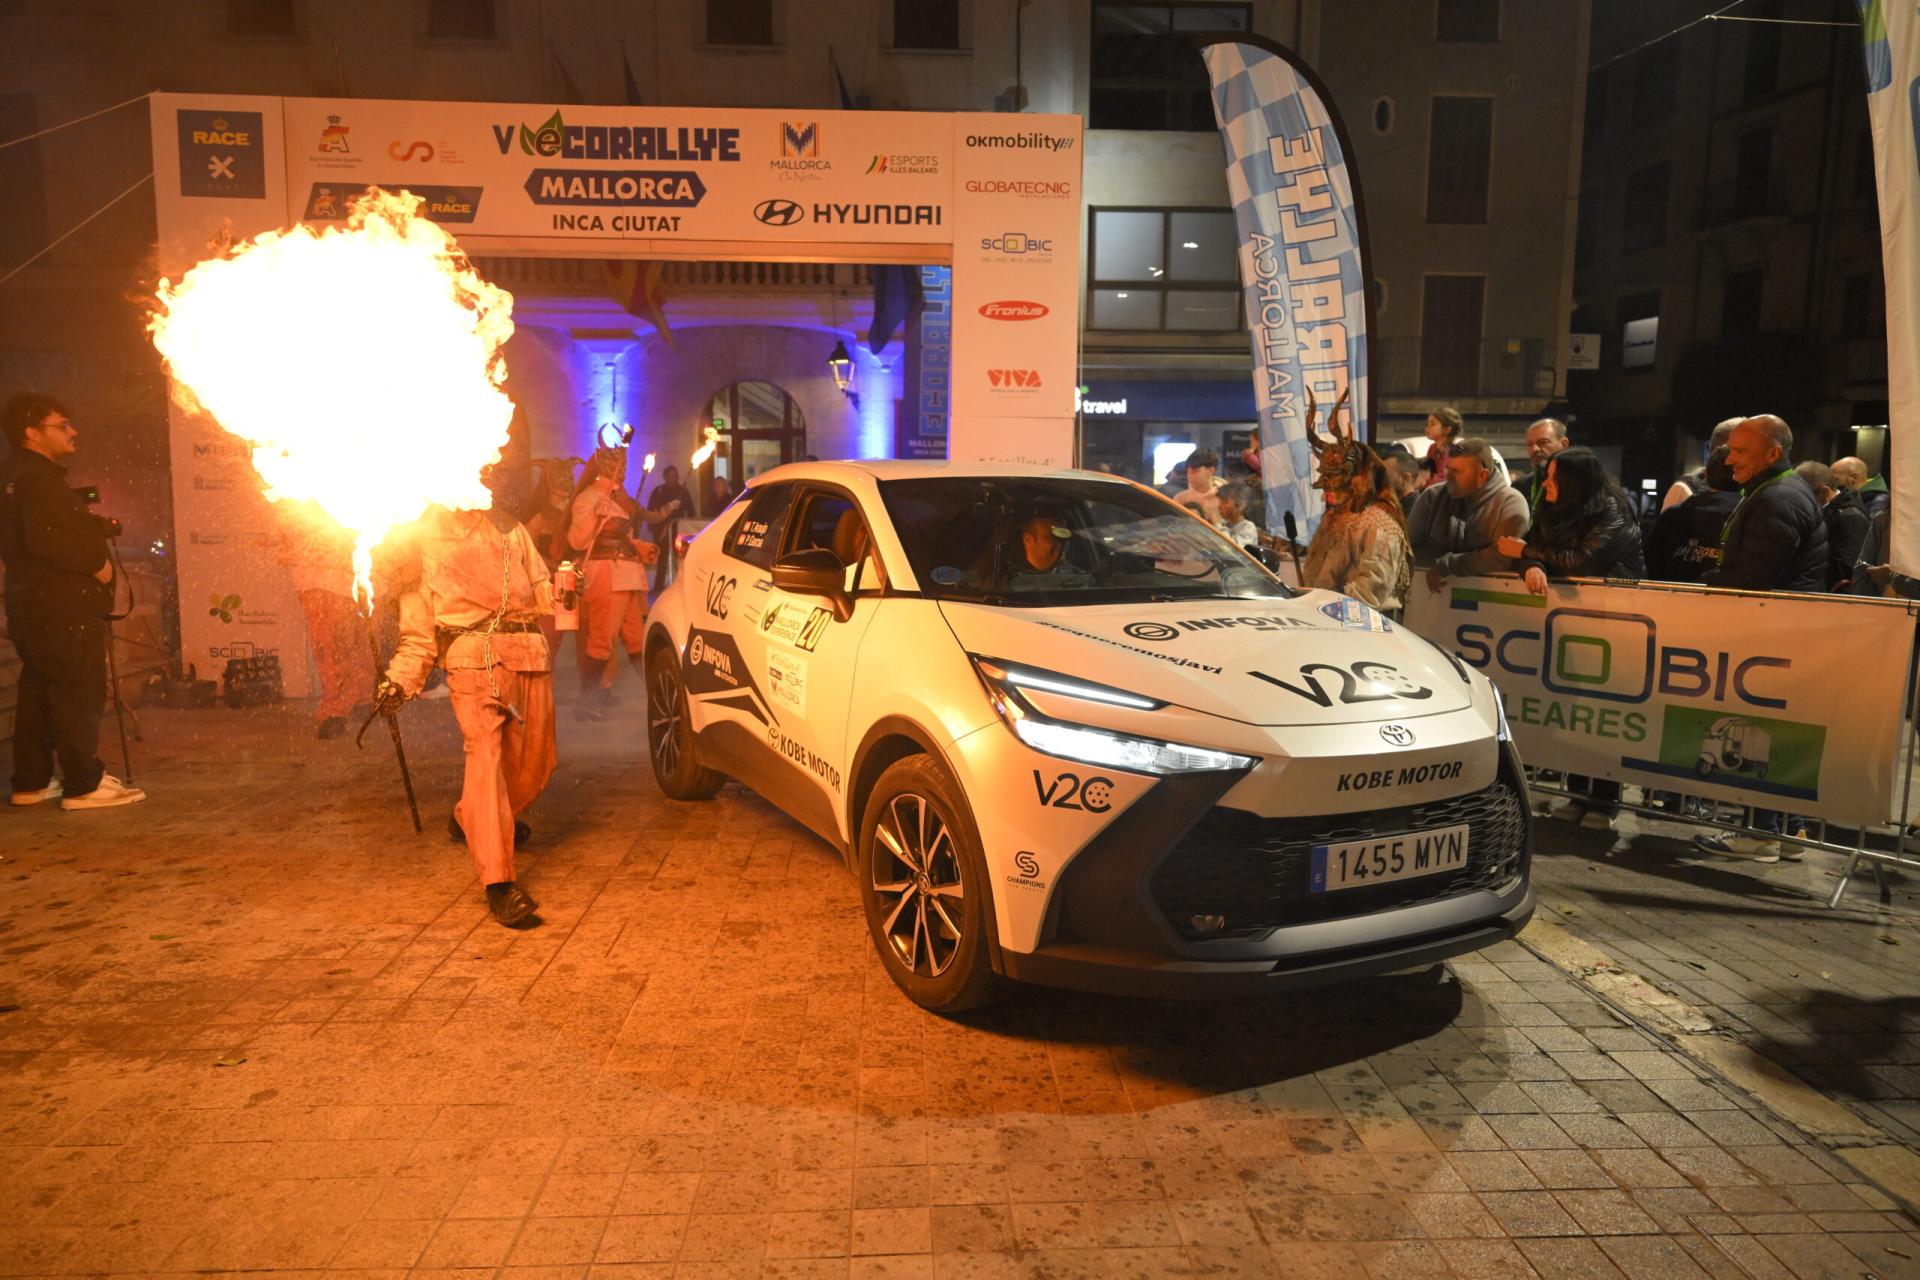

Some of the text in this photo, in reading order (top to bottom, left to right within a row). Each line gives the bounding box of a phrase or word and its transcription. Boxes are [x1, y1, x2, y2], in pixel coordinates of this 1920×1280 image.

[193, 131, 250, 146] RACE
[492, 125, 515, 154] V
[770, 160, 831, 170] MALLORCA
[890, 155, 938, 166] ESPORTS
[540, 176, 695, 200] MALLORCA
[966, 180, 1070, 194] GLOBATECNIC
[431, 203, 472, 213] RACE
[813, 204, 941, 225] HYUNDAI
[553, 214, 681, 232] INCA CIUTAT
[987, 369, 1042, 388] VIVA
[1083, 398, 1127, 414] travel
[706, 571, 737, 620] V2C
[796, 608, 831, 650] 20
[1176, 616, 1316, 632] INFOVA
[703, 643, 732, 674] INFOVA
[1455, 608, 1791, 710] SCOBIC
[1247, 662, 1432, 708] V2C
[1502, 693, 1647, 743] LEARES
[780, 734, 841, 794] KOBE MOTOR
[1337, 761, 1463, 792] KOBE MOTOR
[1032, 769, 1115, 814] V2C
[1339, 842, 1405, 882] 1455
[1415, 831, 1463, 870] MYN
[1006, 875, 1046, 889] CHAMPIONS
